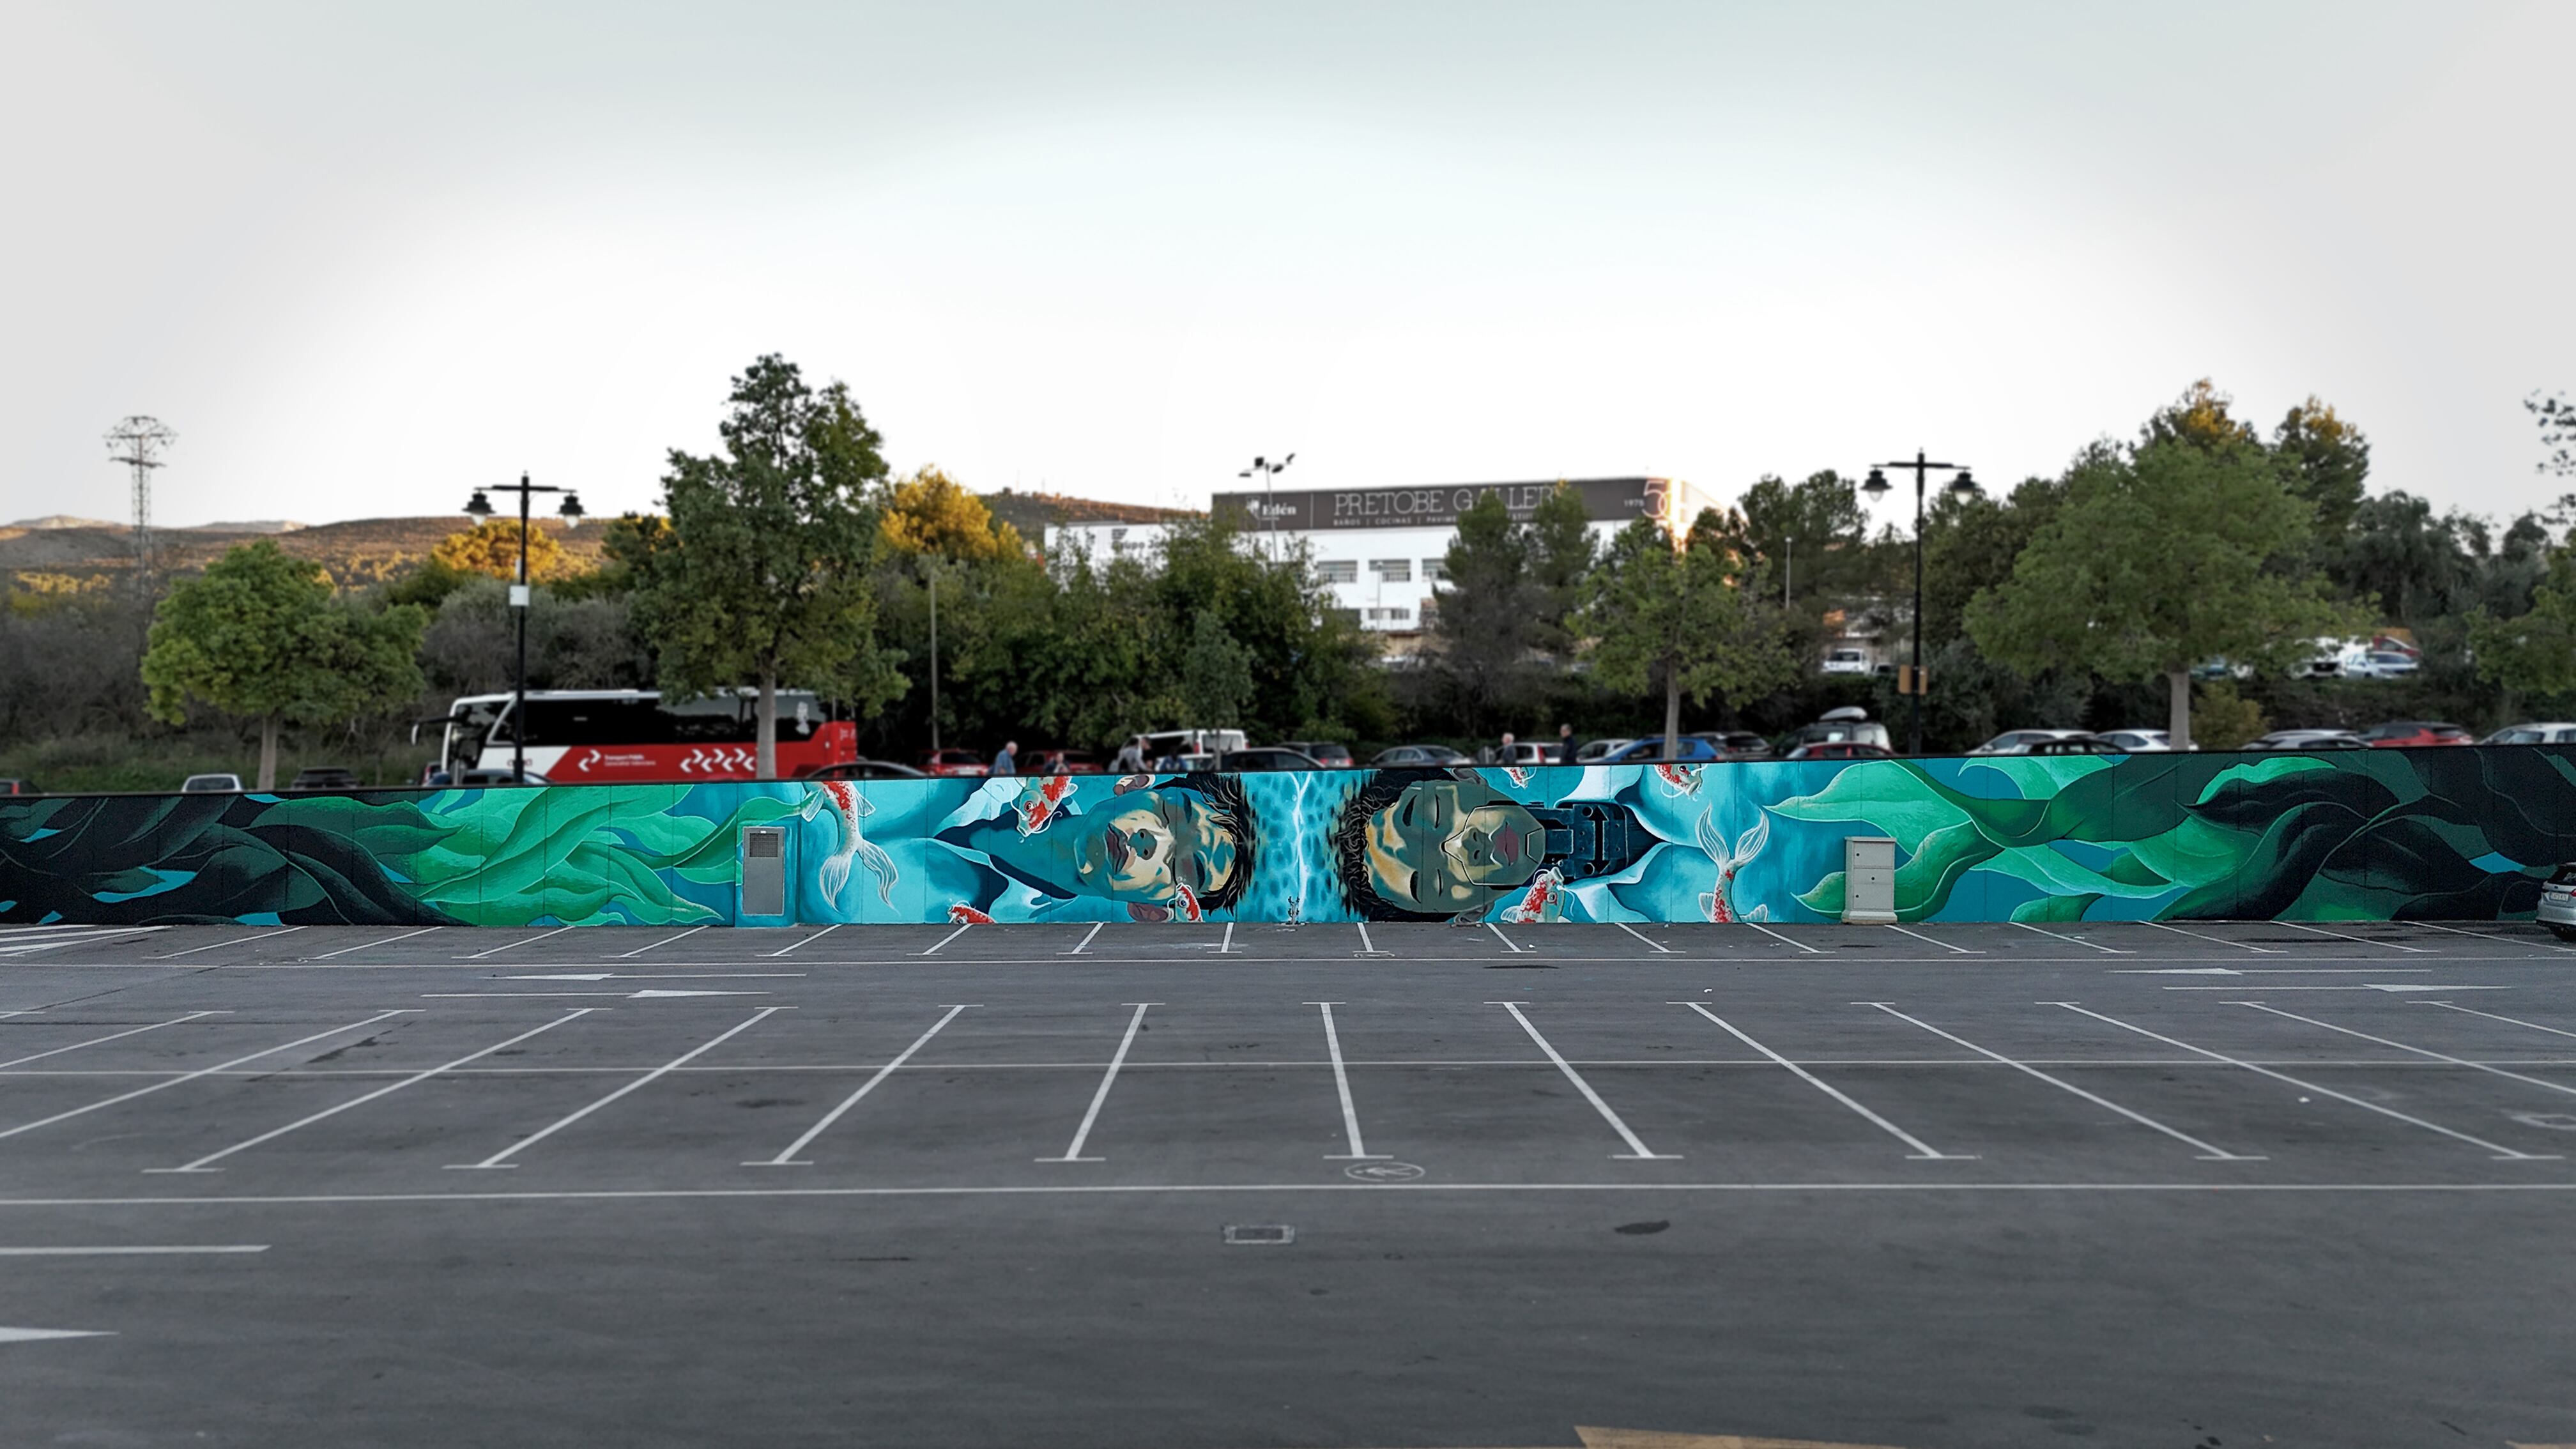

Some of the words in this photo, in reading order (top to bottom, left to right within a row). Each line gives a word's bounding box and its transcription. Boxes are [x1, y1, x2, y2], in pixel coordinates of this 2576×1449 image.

[1334, 490, 1444, 516] PRETOBE
[1453, 486, 1561, 510] GLER
[1262, 502, 1296, 516] Edén
[1333, 518, 1361, 526] BAÑOS
[1375, 517, 1411, 525] COCINAS
[1426, 514, 1457, 523] PAVIME
